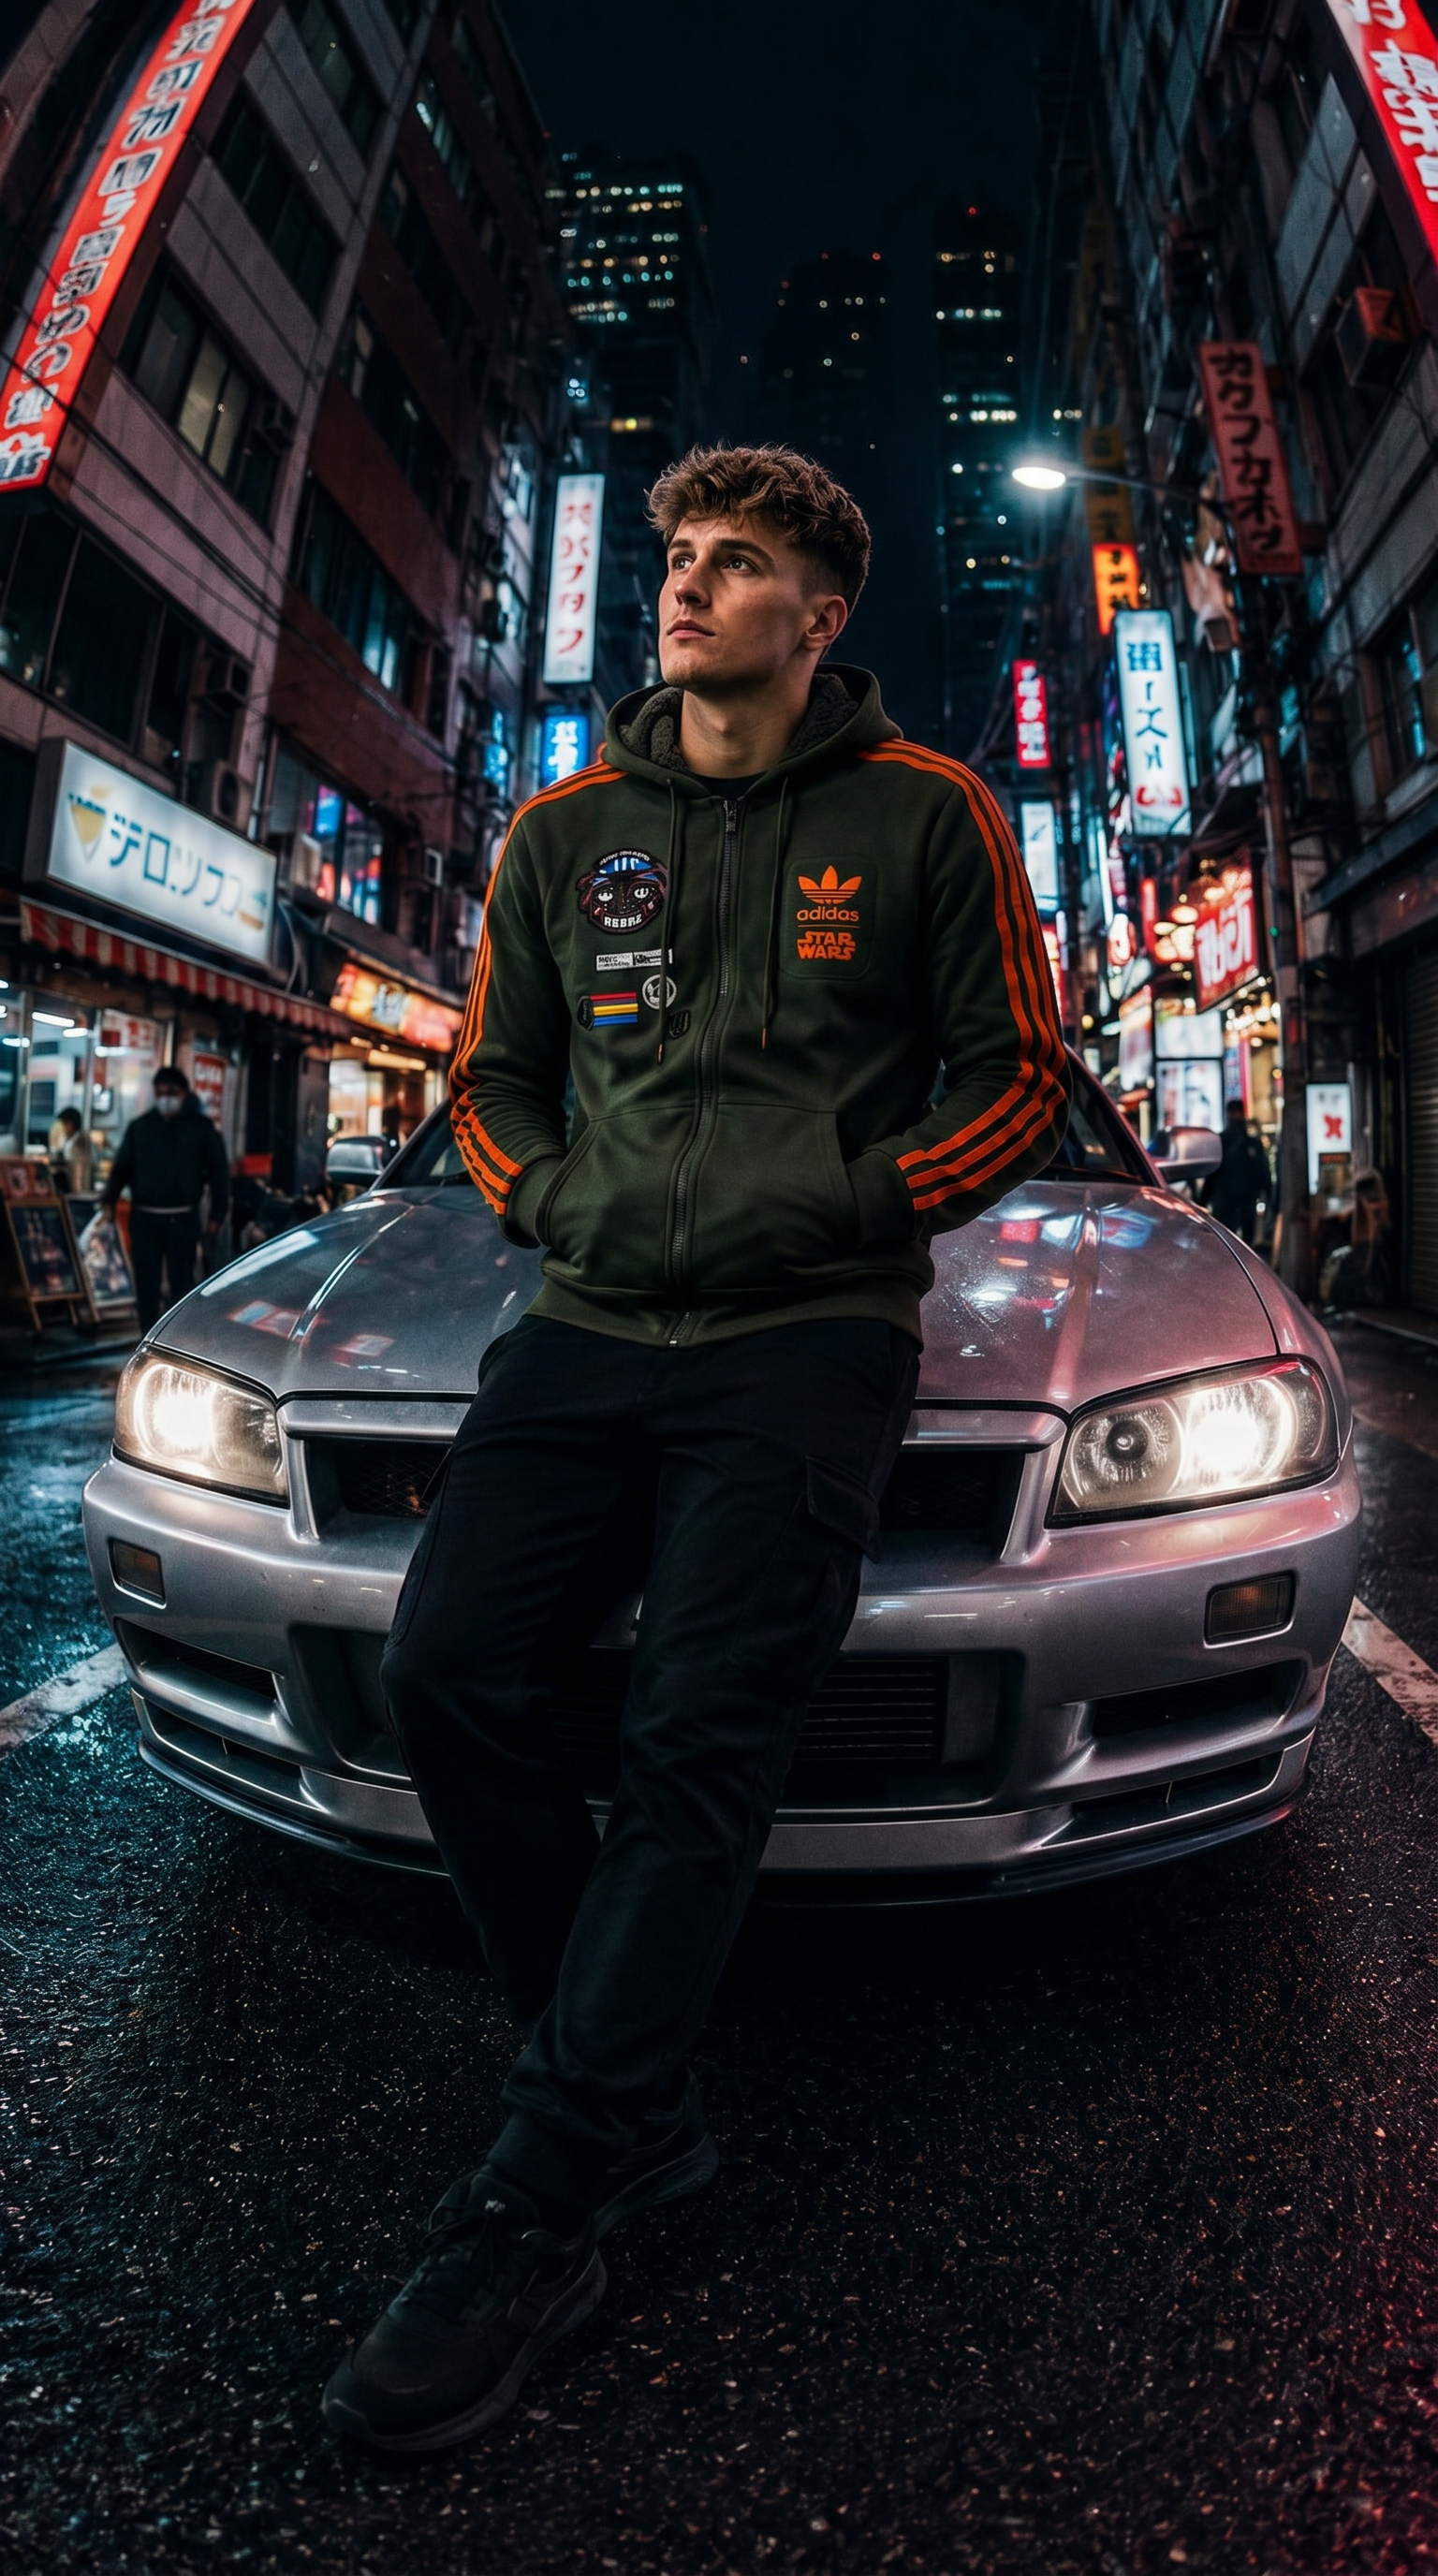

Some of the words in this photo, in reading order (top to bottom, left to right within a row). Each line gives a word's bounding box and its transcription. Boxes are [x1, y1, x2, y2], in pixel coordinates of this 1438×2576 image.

[797, 906, 859, 921] adidas
[797, 930, 856, 946] STAR
[797, 944, 856, 960] WARS
